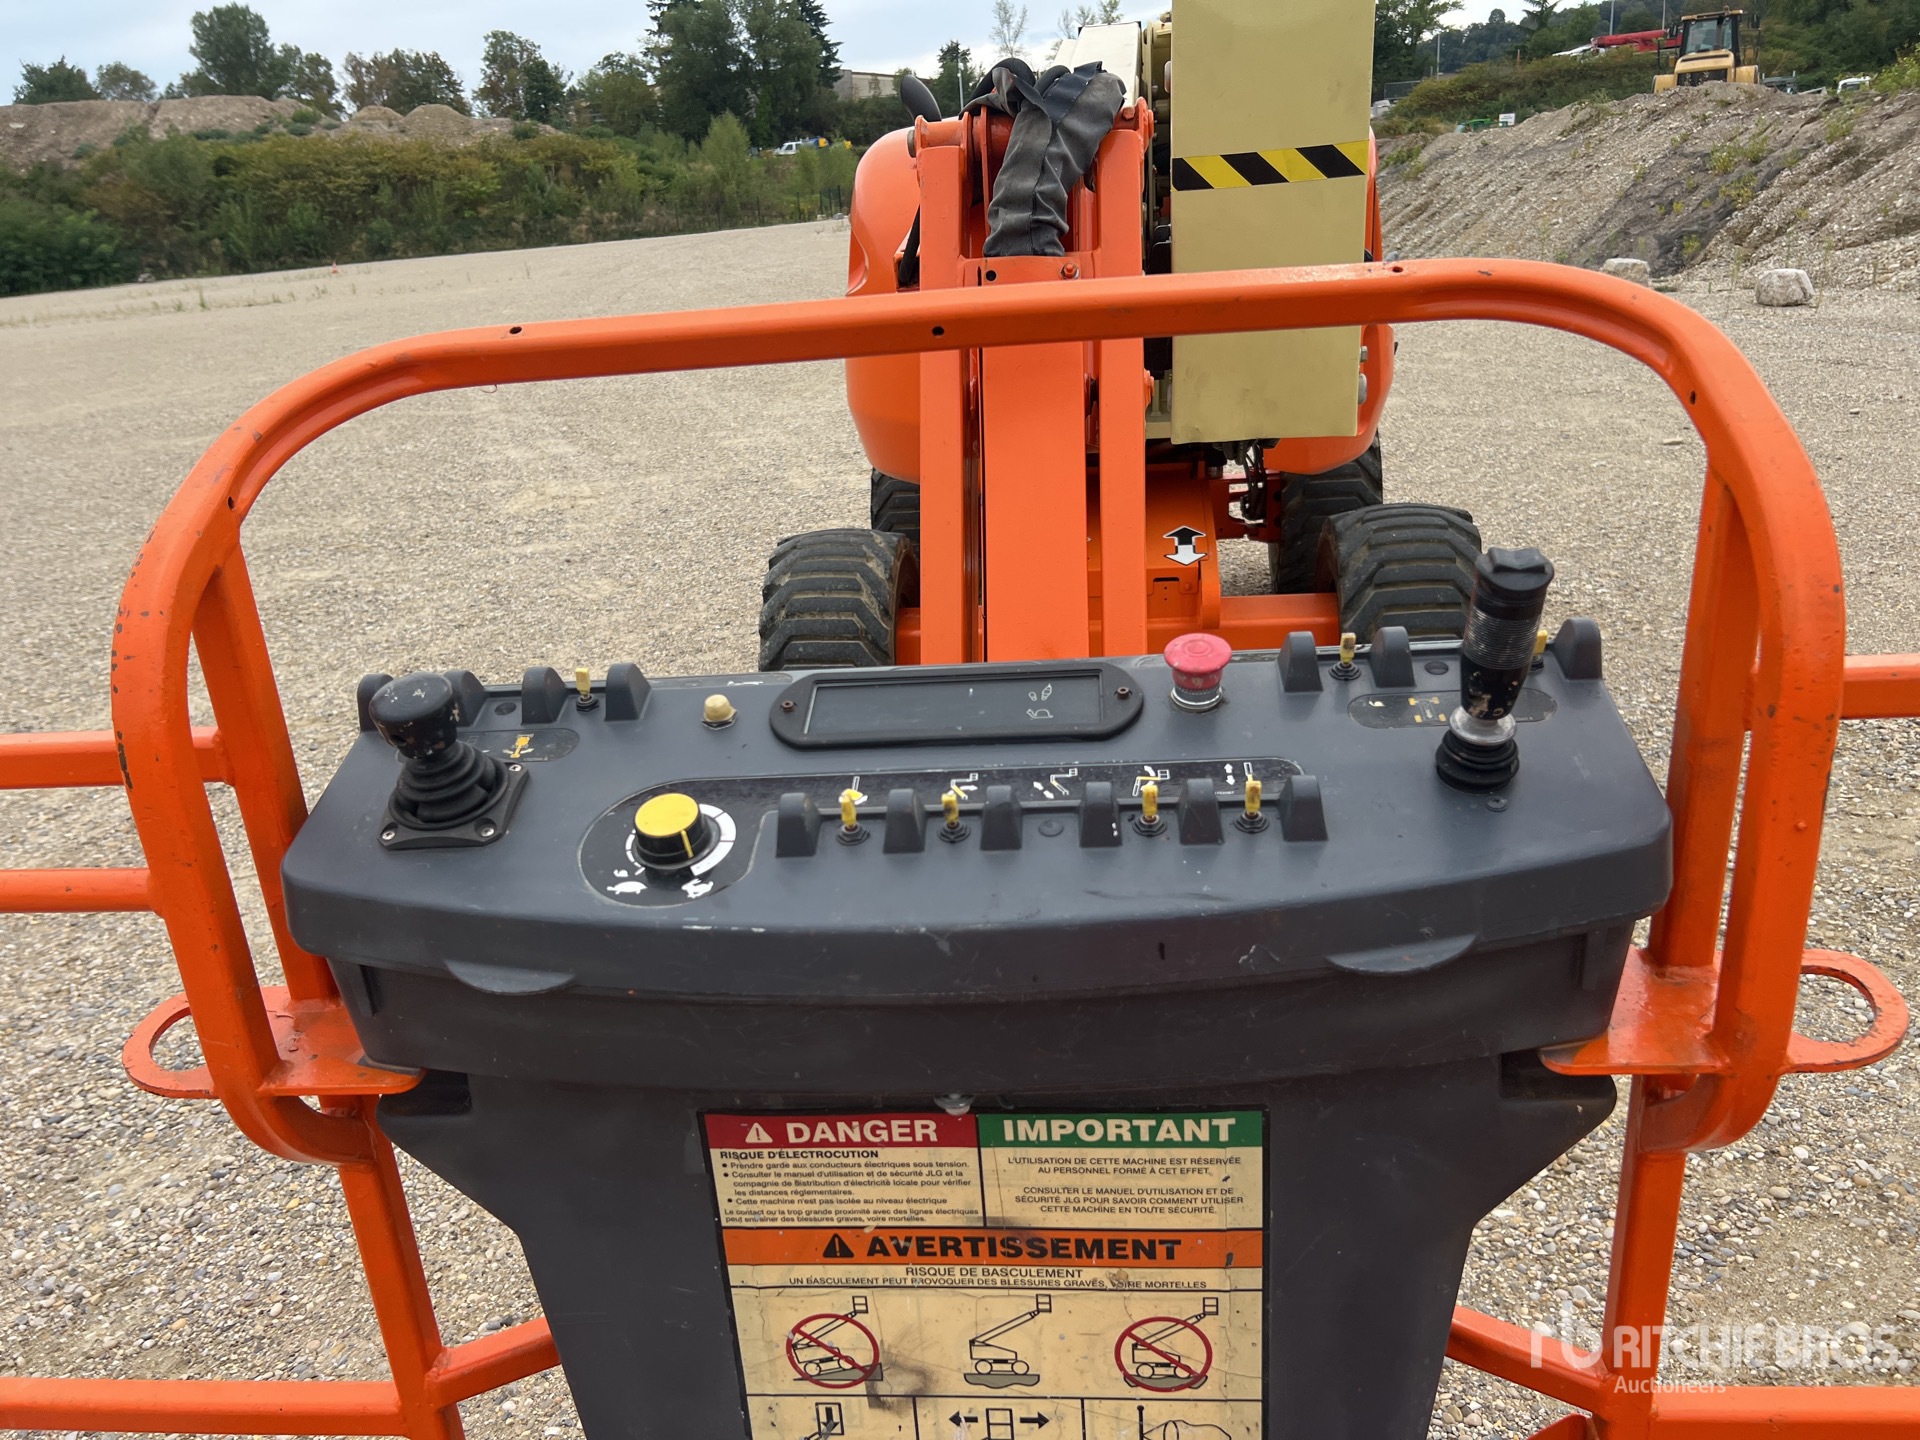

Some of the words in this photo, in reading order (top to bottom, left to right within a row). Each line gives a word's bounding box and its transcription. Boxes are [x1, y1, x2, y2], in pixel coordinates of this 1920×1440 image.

[786, 1119, 938, 1143] DANGER
[1003, 1118, 1236, 1142] IMPORTANT
[720, 1151, 765, 1160] RISQUE
[767, 1149, 879, 1160] D'ÉLECTROCUTION
[730, 1161, 764, 1169] Prendre
[766, 1161, 790, 1170] garde
[810, 1161, 863, 1169] conducteurs
[864, 1160, 911, 1170] électriques
[1008, 1157, 1072, 1165] L'UTILISATION
[1090, 1157, 1120, 1165] CETTE
[1122, 1157, 1167, 1165] MACHINE
[1190, 1156, 1242, 1165] RÉSERVÉE
[784, 1170, 815, 1178] manuel
[817, 1170, 865, 1178] d'utilisation
[1038, 1166, 1051, 1174] AU
[1113, 1166, 1147, 1174] FORMÉ
[733, 1180, 780, 1188] compagnie
[843, 1179, 891, 1187] d'électricité
[921, 1180, 940, 1188] pour
[942, 1179, 971, 1187] vérifier
[748, 1188, 789, 1196] distances
[1023, 1186, 1080, 1195] CONSULTER
[1081, 1187, 1093, 1195] LE
[1095, 1187, 1135, 1195] MANUEL
[1137, 1187, 1204, 1195] D'UTILISATION
[1206, 1187, 1218, 1195] ET
[1220, 1187, 1234, 1195] DE
[736, 1197, 758, 1205] Cette
[760, 1197, 796, 1205] machine
[797, 1197, 817, 1205] n'est
[819, 1198, 835, 1206] pas
[836, 1197, 862, 1205] isolée
[876, 1197, 904, 1205] niveau
[906, 1197, 948, 1206] électrique
[1015, 1195, 1061, 1204] SÉCURITÉ
[1063, 1196, 1081, 1204] JLG
[1083, 1196, 1110, 1204] POUR
[1200, 1196, 1244, 1204] UTILISER
[834, 1208, 871, 1216] proximité
[909, 1208, 934, 1216] lignes
[935, 1208, 979, 1216] électriques
[866, 1235, 1182, 1260] AVERTISSEMENT
[905, 1266, 956, 1277] RISQUE
[959, 1267, 978, 1277] DE
[981, 1267, 1084, 1278] BASCULEMENT
[789, 1277, 804, 1285] UN
[806, 1277, 879, 1286] BASCULEMENT
[911, 1277, 975, 1286] PROVOQUER
[977, 1278, 998, 1286] DES
[1000, 1279, 1061, 1287] BLESSURES
[1144, 1281, 1207, 1289] MORTELLES
